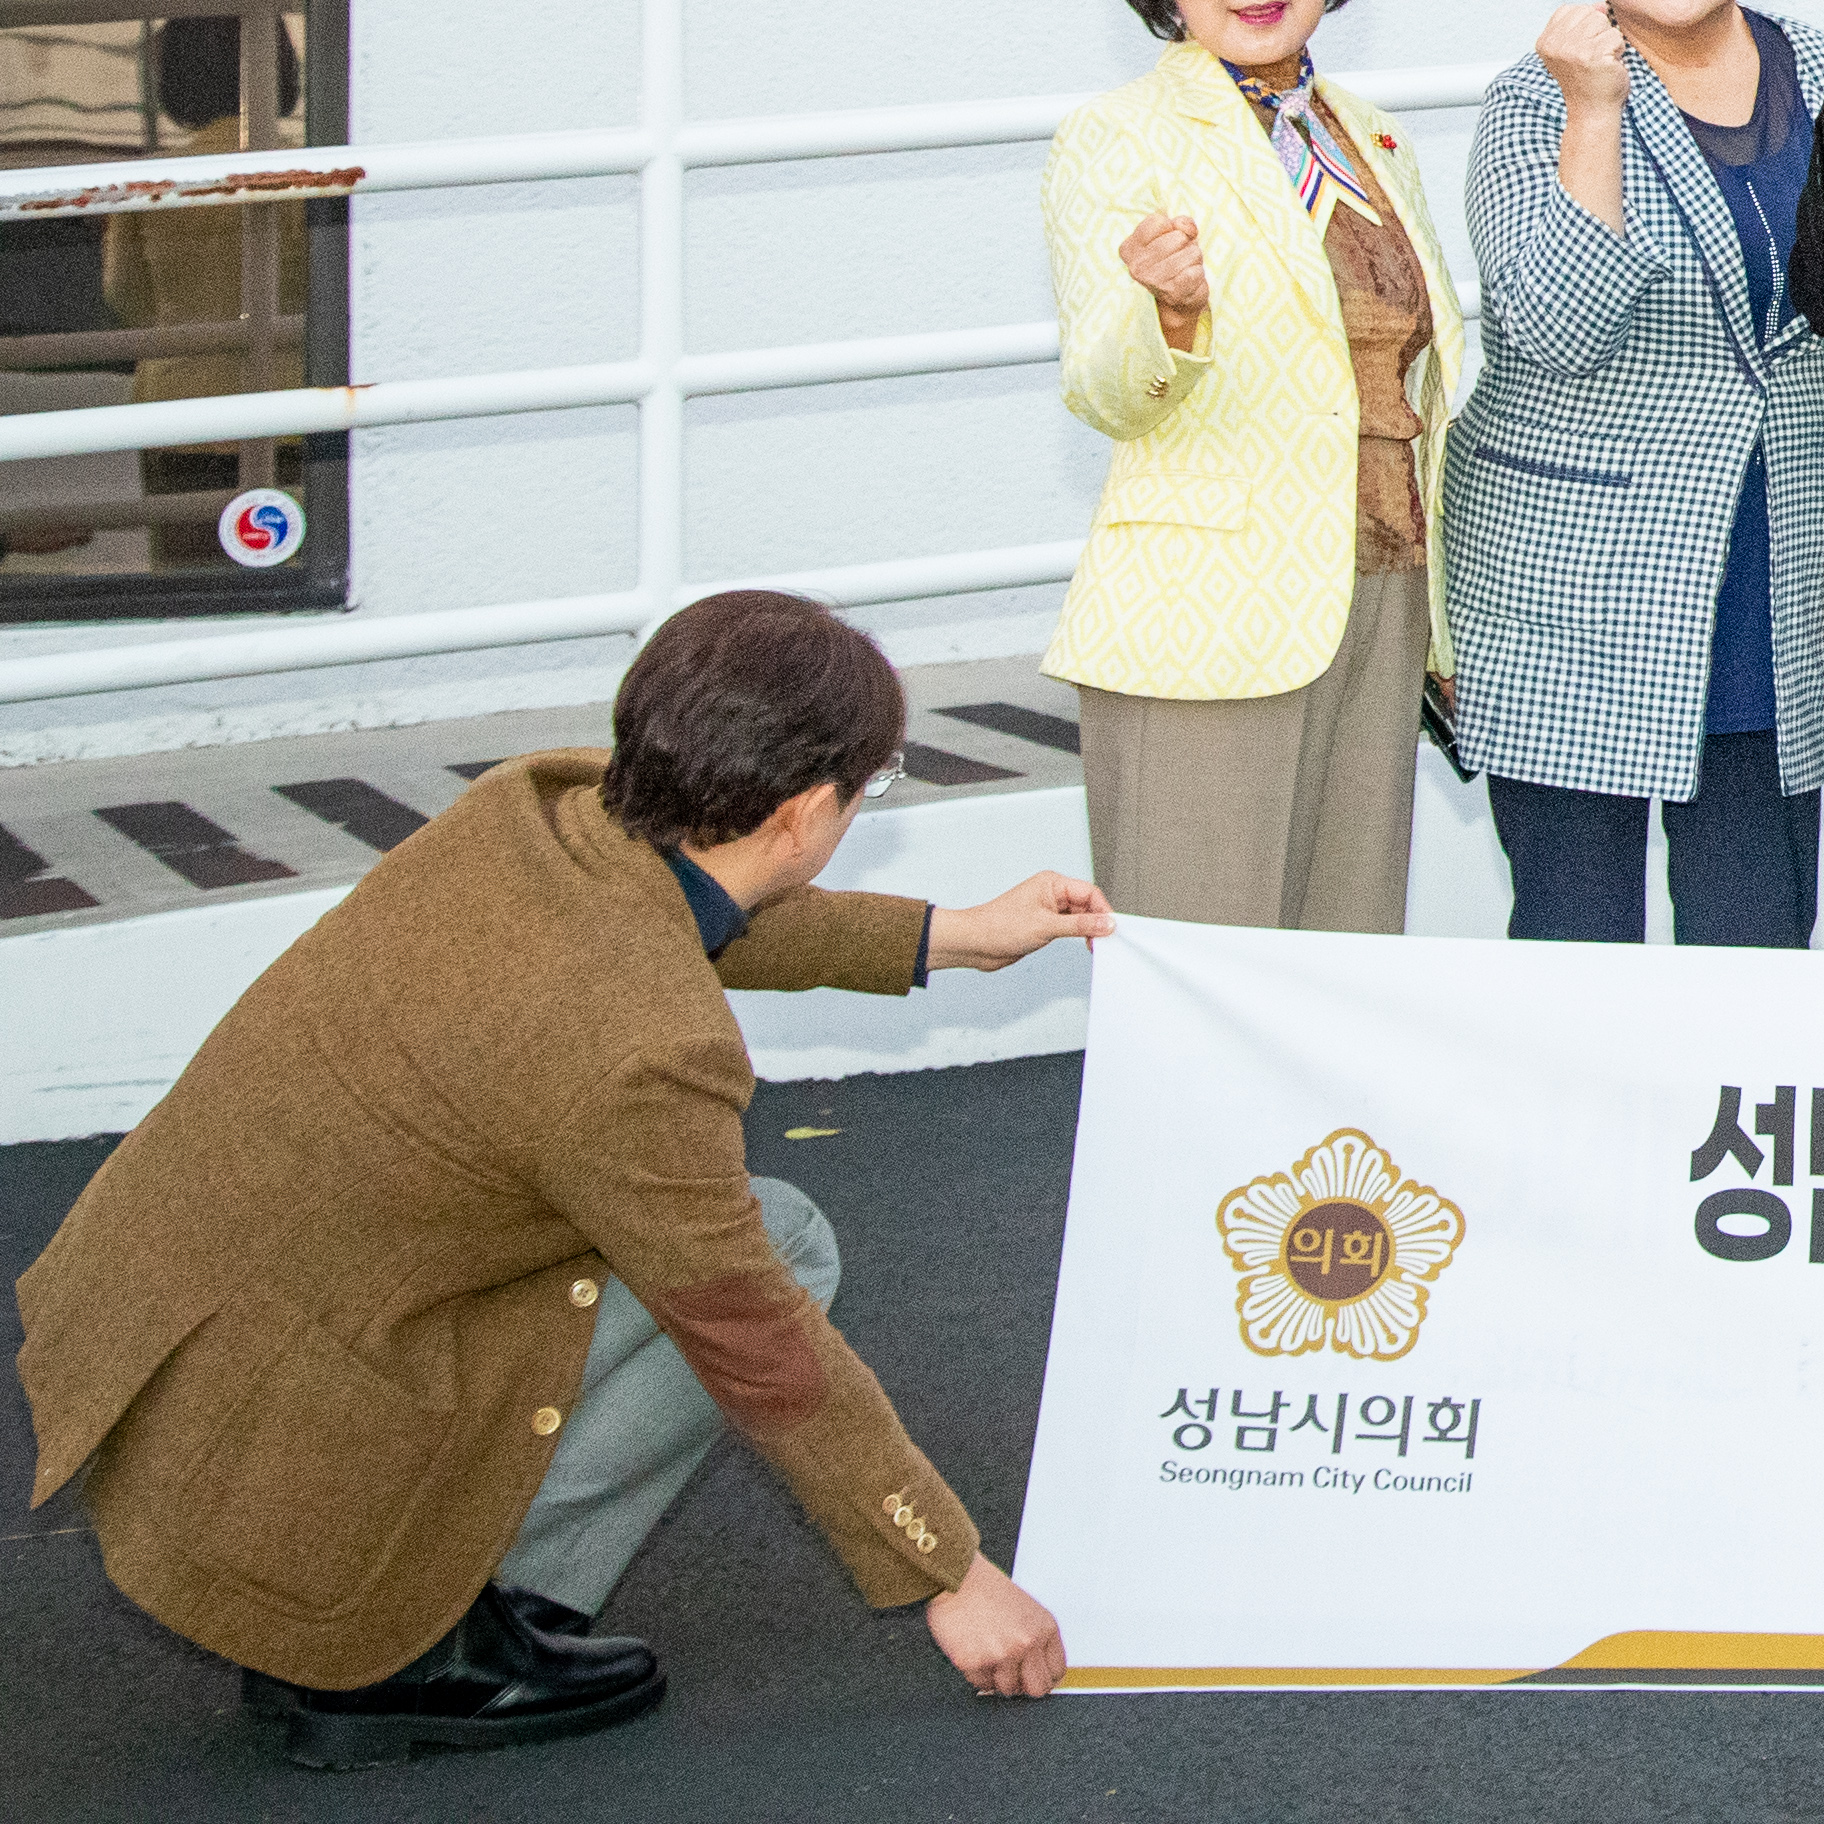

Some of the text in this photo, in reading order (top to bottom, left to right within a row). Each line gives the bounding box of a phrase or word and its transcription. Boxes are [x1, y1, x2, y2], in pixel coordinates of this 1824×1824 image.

[1290, 1227, 1384, 1278] 의회
[1159, 1387, 1482, 1460] 성남시의회
[1159, 1460, 1474, 1495] Seongnam City Council
